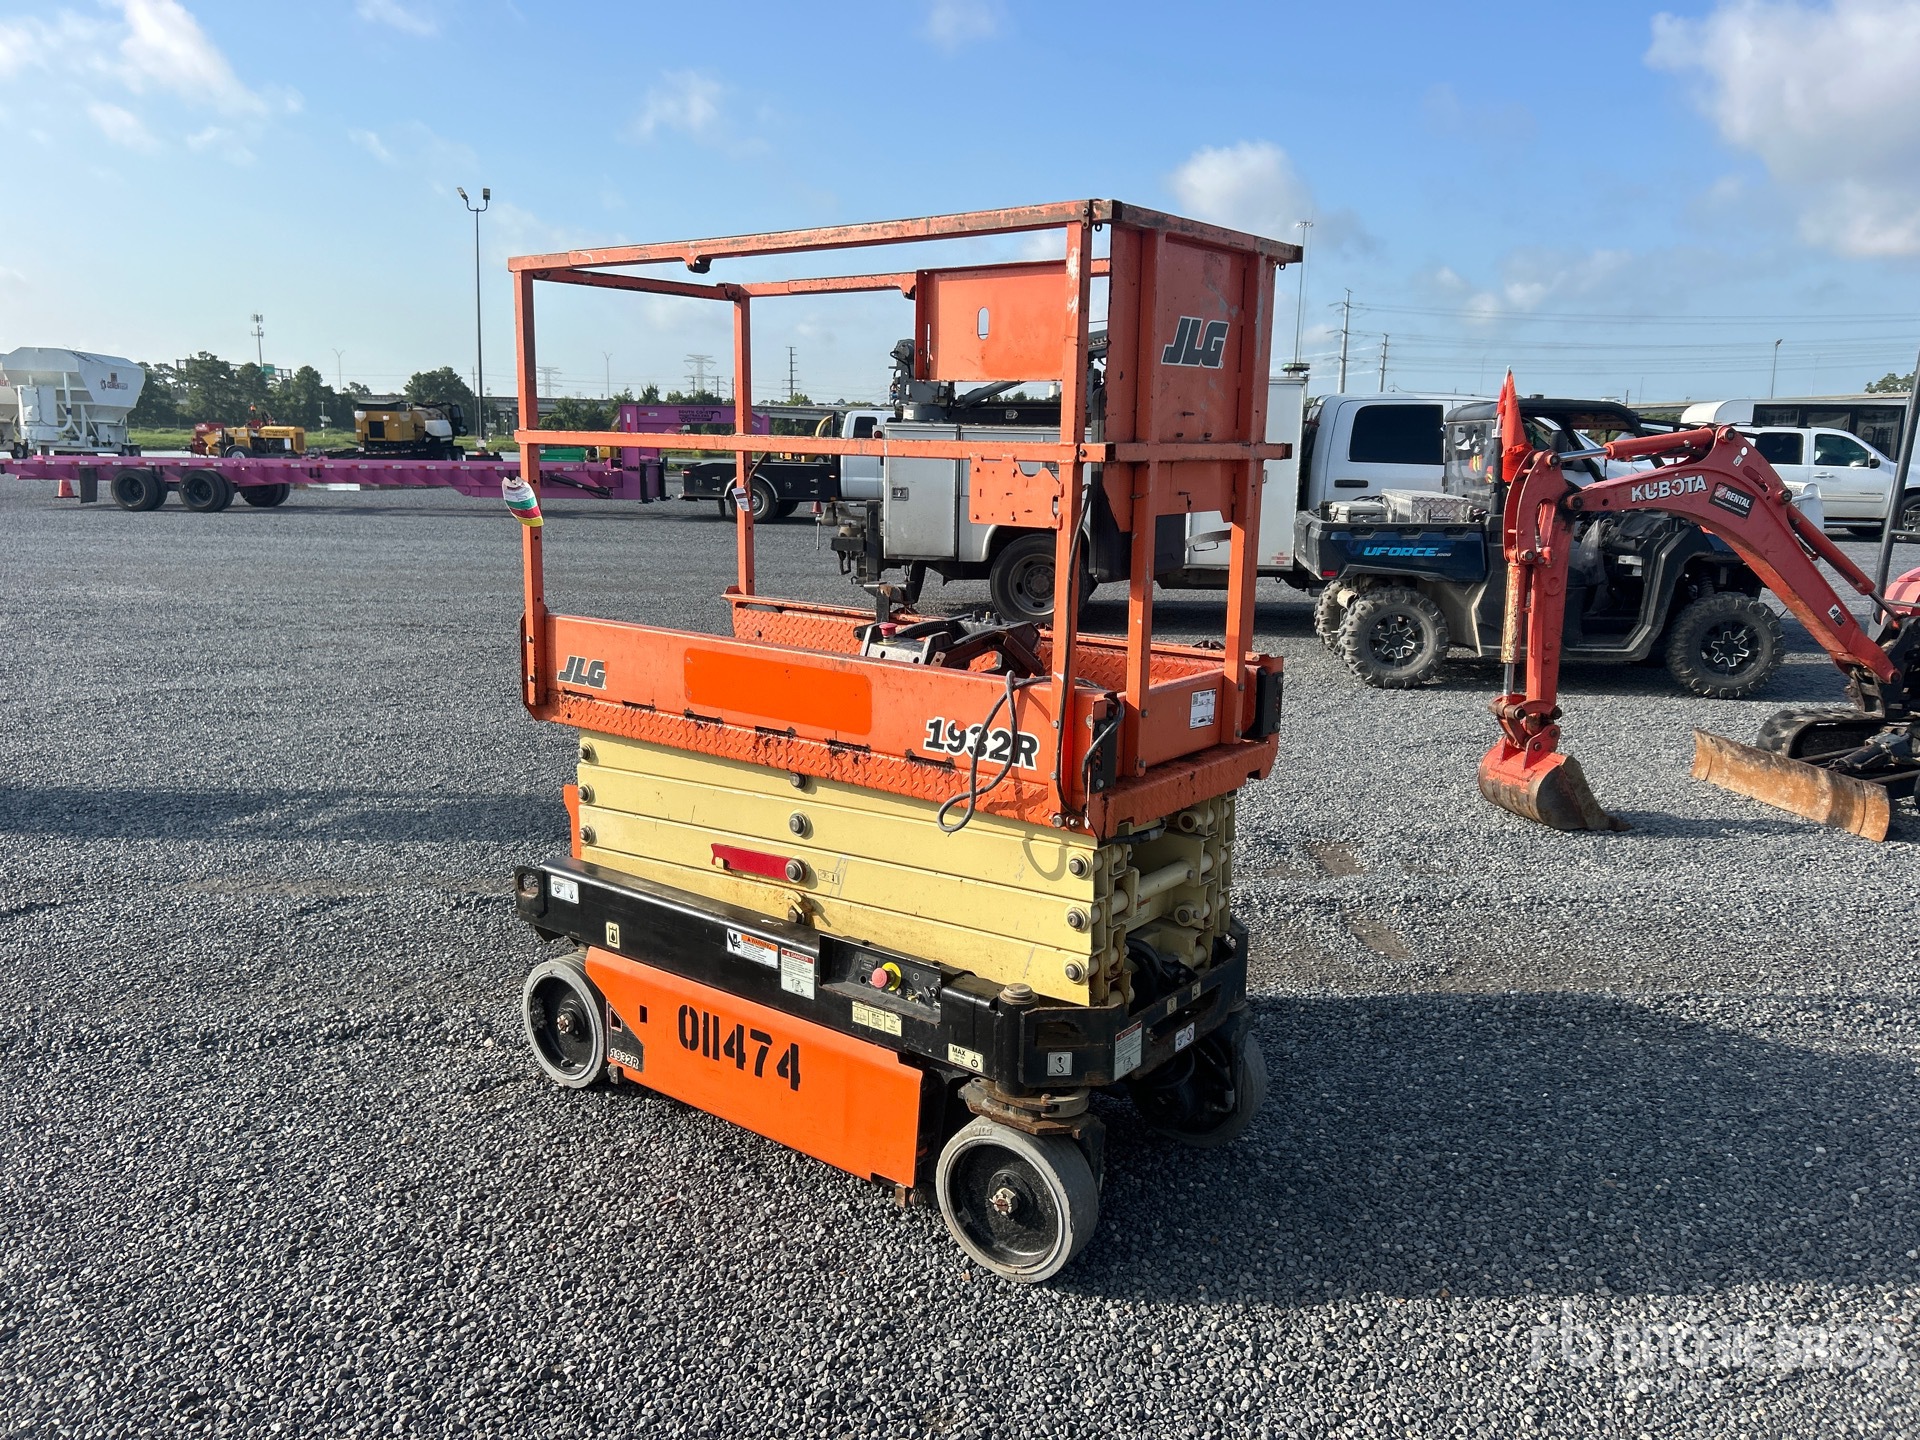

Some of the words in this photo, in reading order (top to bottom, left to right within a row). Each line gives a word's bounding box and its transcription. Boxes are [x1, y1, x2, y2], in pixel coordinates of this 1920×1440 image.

[1161, 316, 1229, 369] JLG
[1630, 474, 1708, 503] KUBOTA
[1725, 490, 1751, 509] RENTAL
[1363, 546, 1439, 557] UFORCE
[556, 654, 607, 690] JLG
[922, 715, 1038, 771] 1932R
[791, 952, 809, 963] DANGER
[609, 1047, 640, 1070] 1932R
[677, 1004, 801, 1092] 011474
[951, 1046, 966, 1057] MAX
